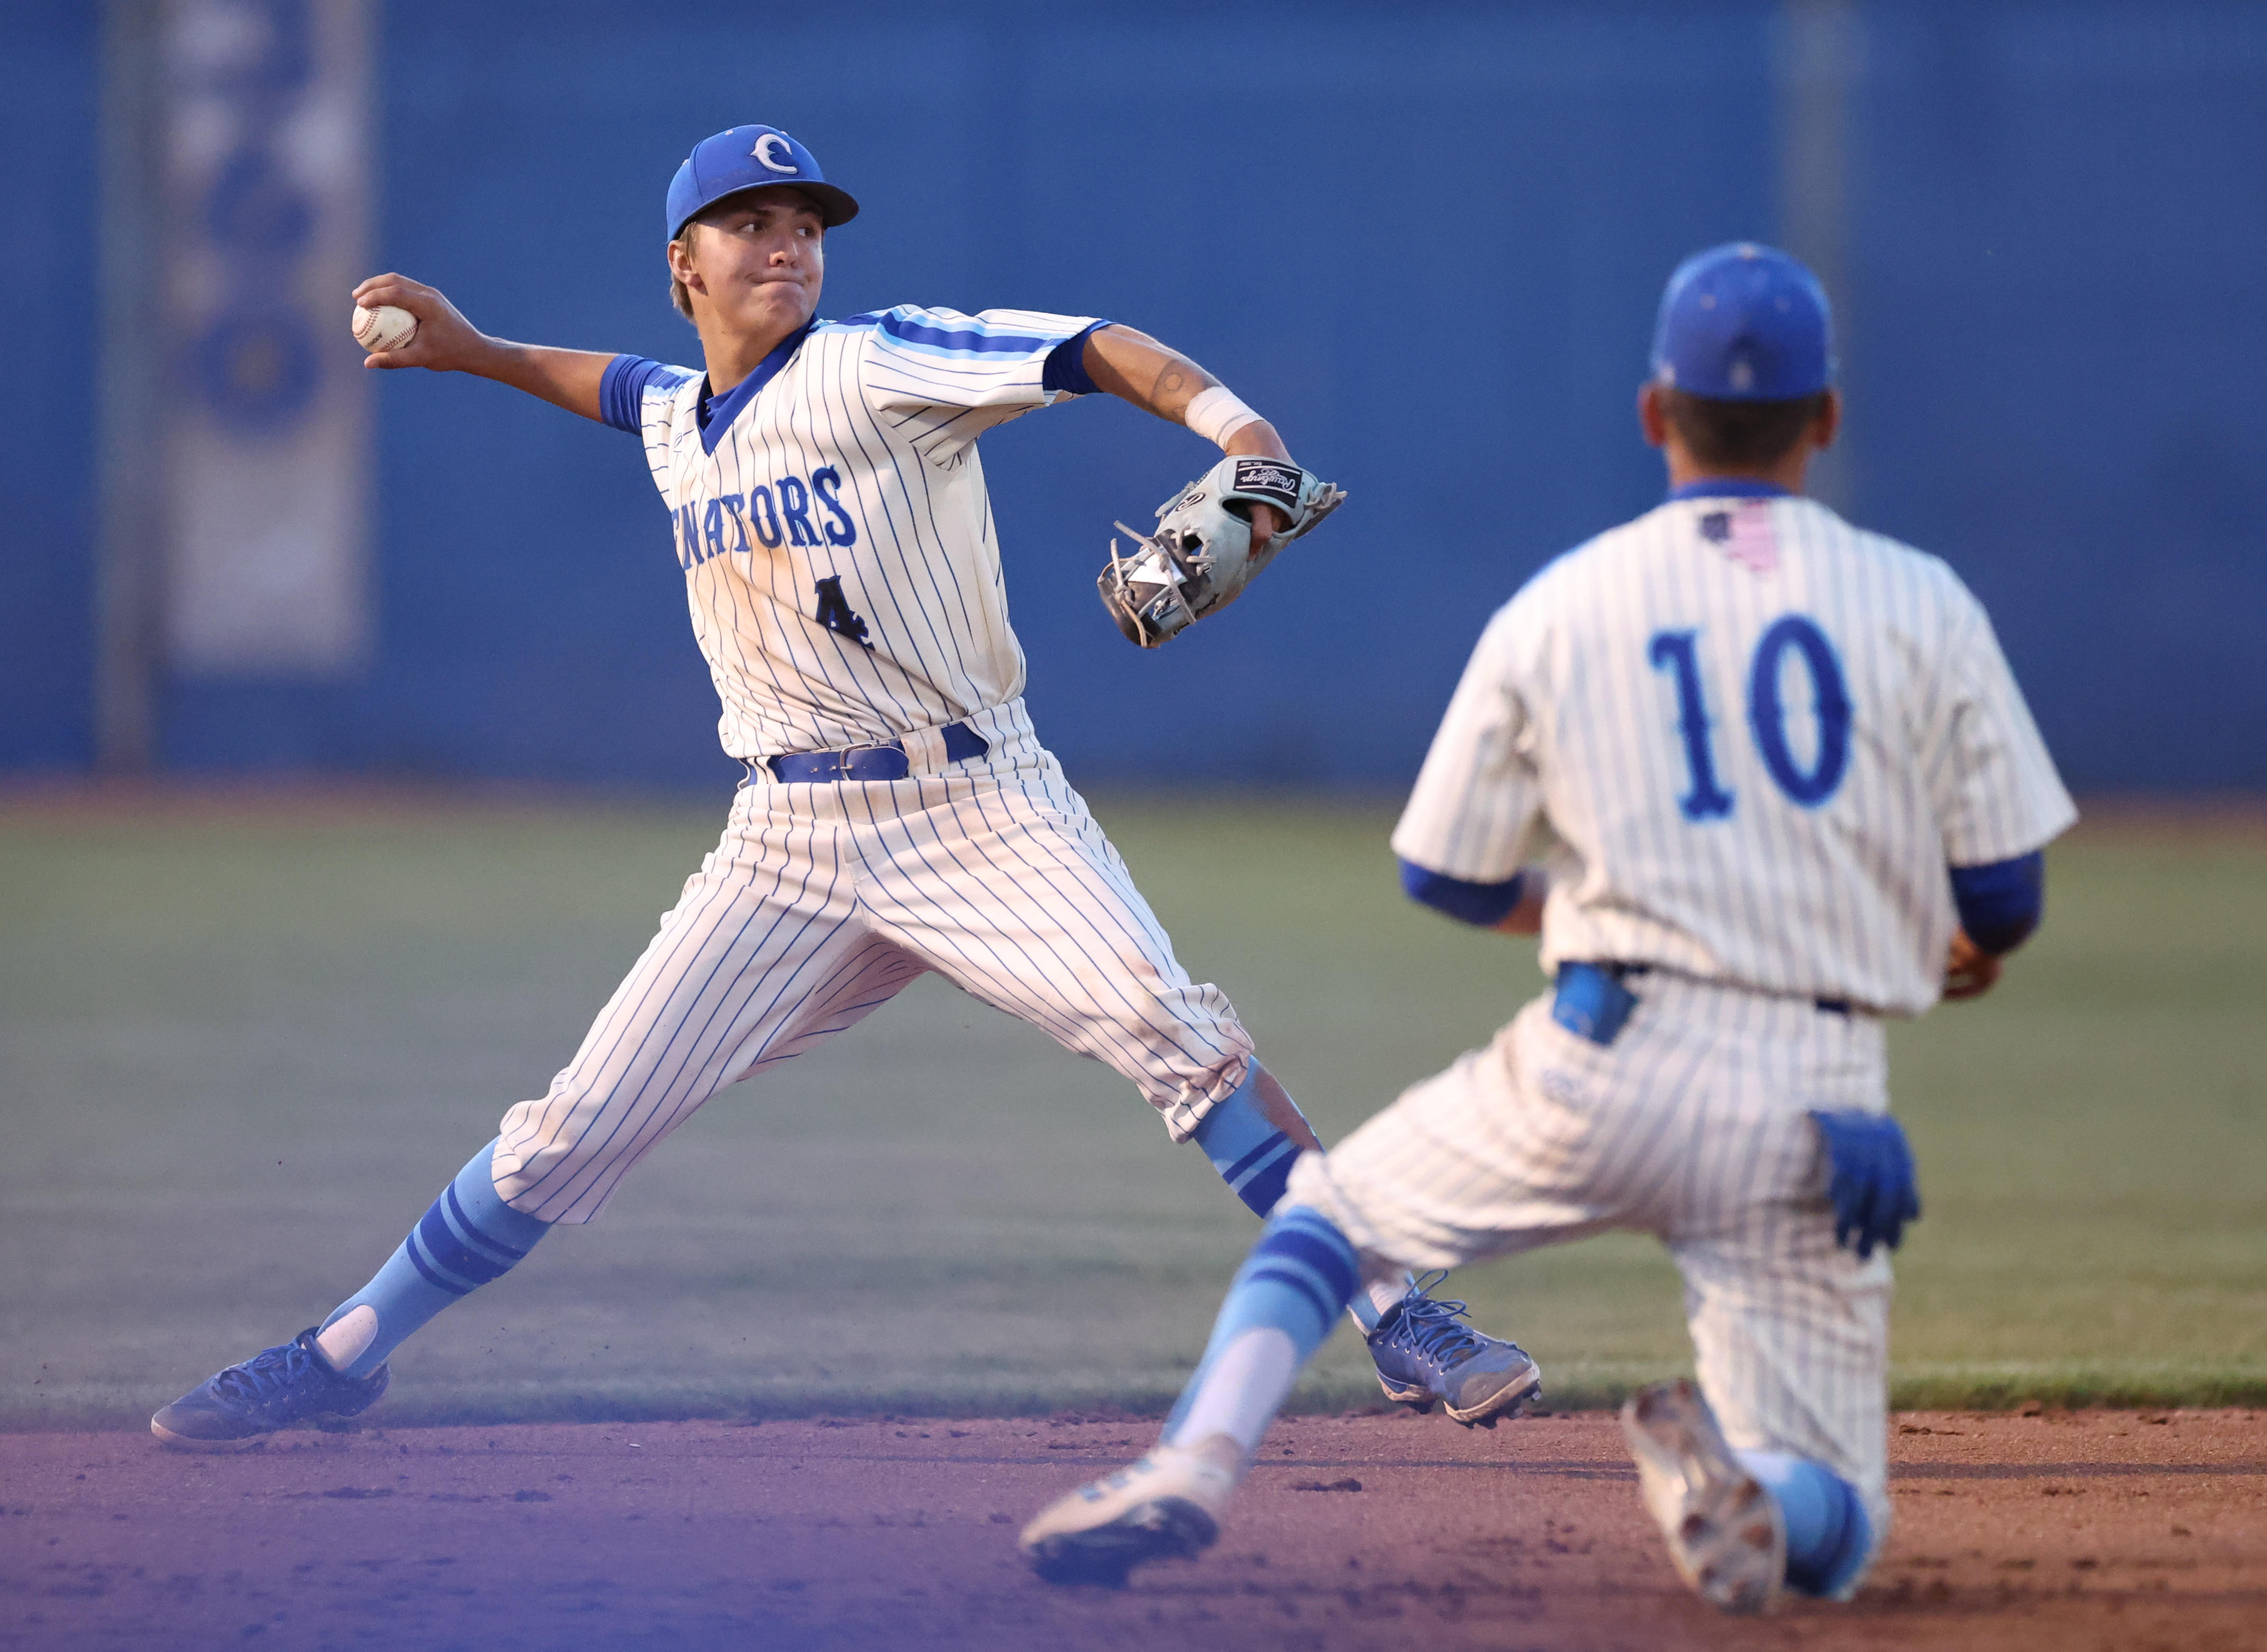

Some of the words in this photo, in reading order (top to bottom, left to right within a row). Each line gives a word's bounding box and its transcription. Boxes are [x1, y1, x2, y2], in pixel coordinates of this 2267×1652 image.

[749, 133, 798, 175] C
[1240, 469, 1295, 491] Rawlings
[815, 575, 876, 652] 4
[1647, 611, 1853, 822] 10
